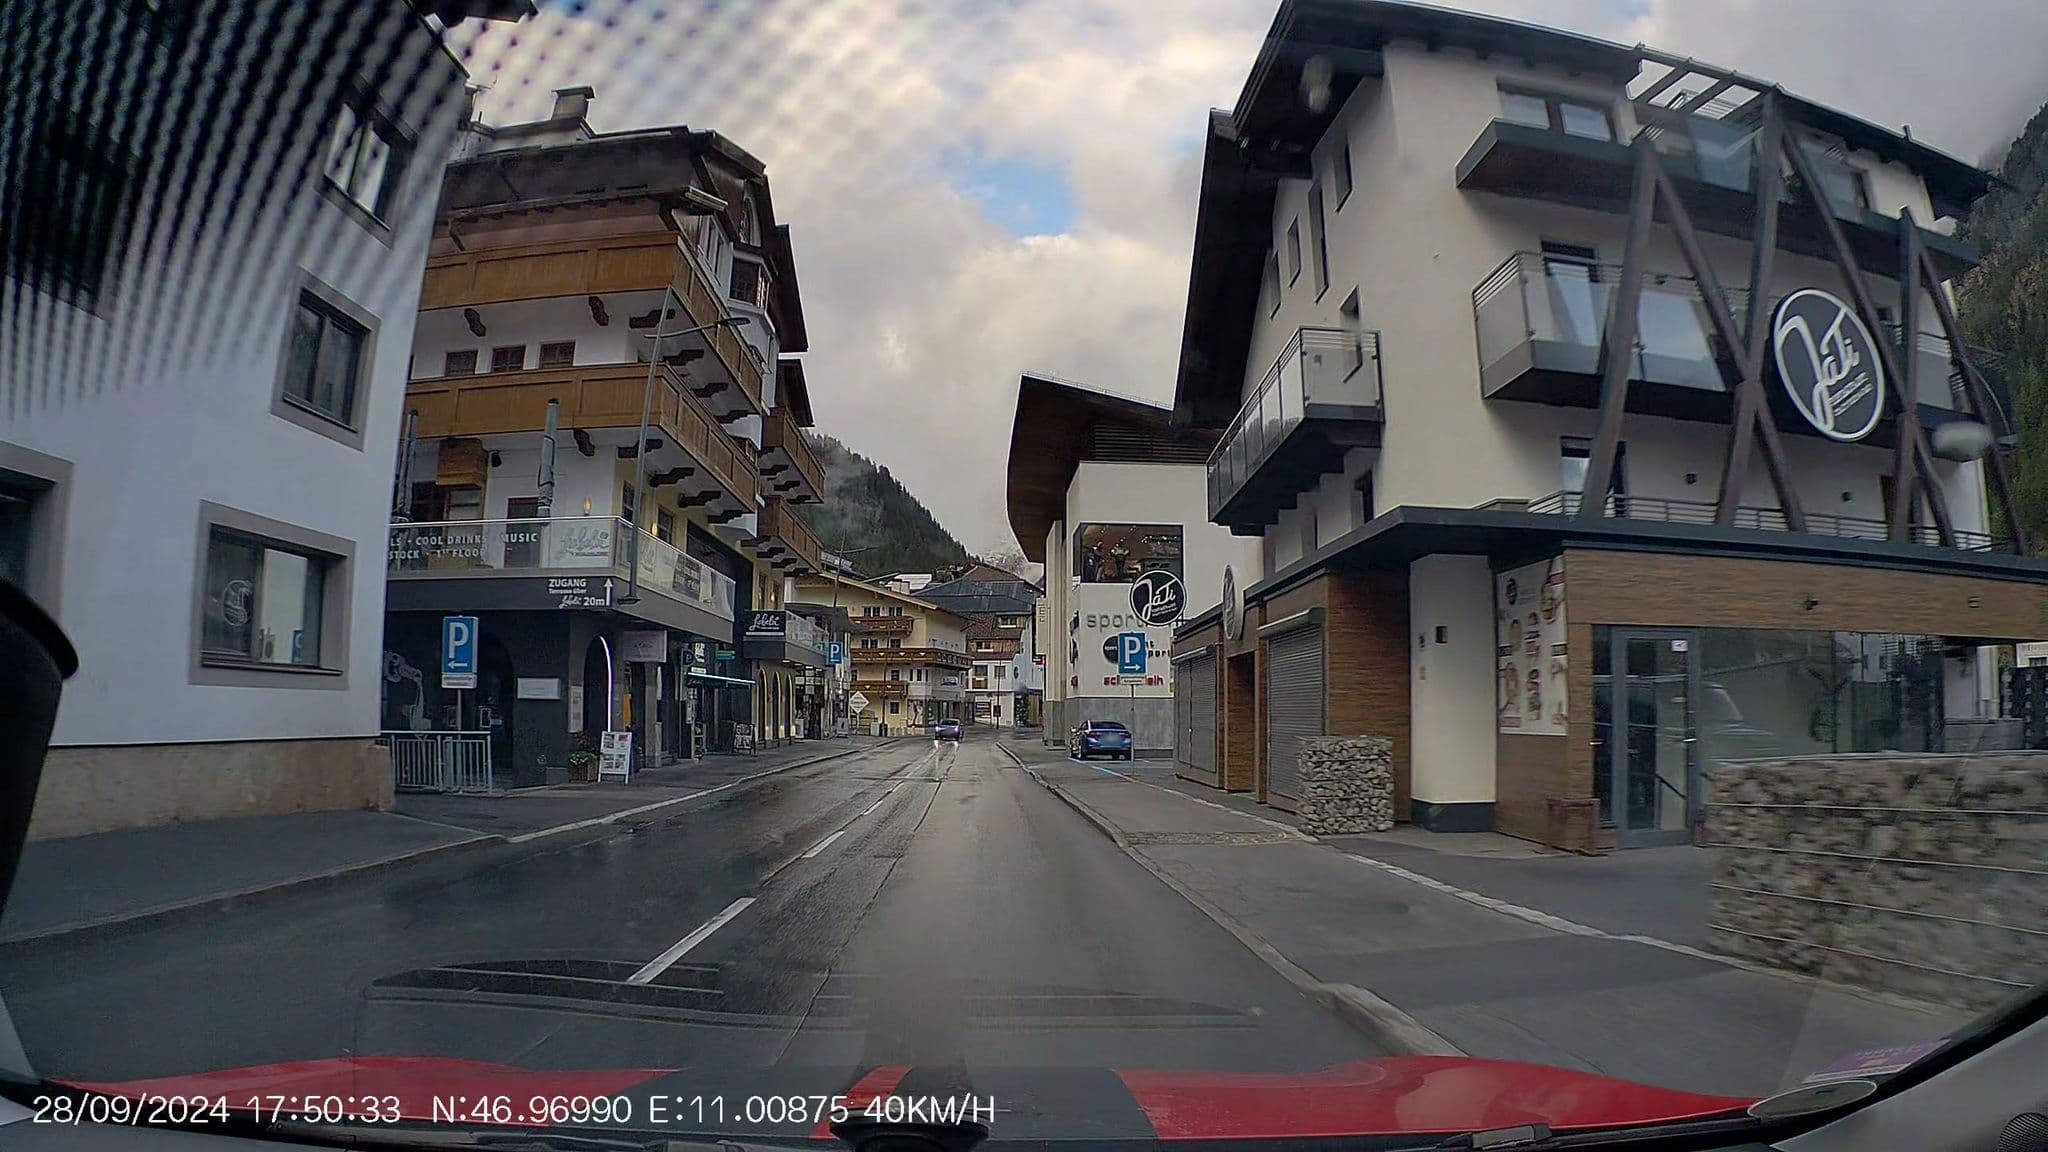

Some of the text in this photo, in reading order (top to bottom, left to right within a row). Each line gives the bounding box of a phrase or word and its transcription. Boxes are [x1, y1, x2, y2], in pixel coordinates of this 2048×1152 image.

[415, 536, 443, 546] COOL
[548, 578, 587, 588] ZUGANG
[583, 596, 606, 606] 20m
[448, 622, 469, 659] P
[830, 643, 840, 659] P
[1124, 636, 1142, 664] P
